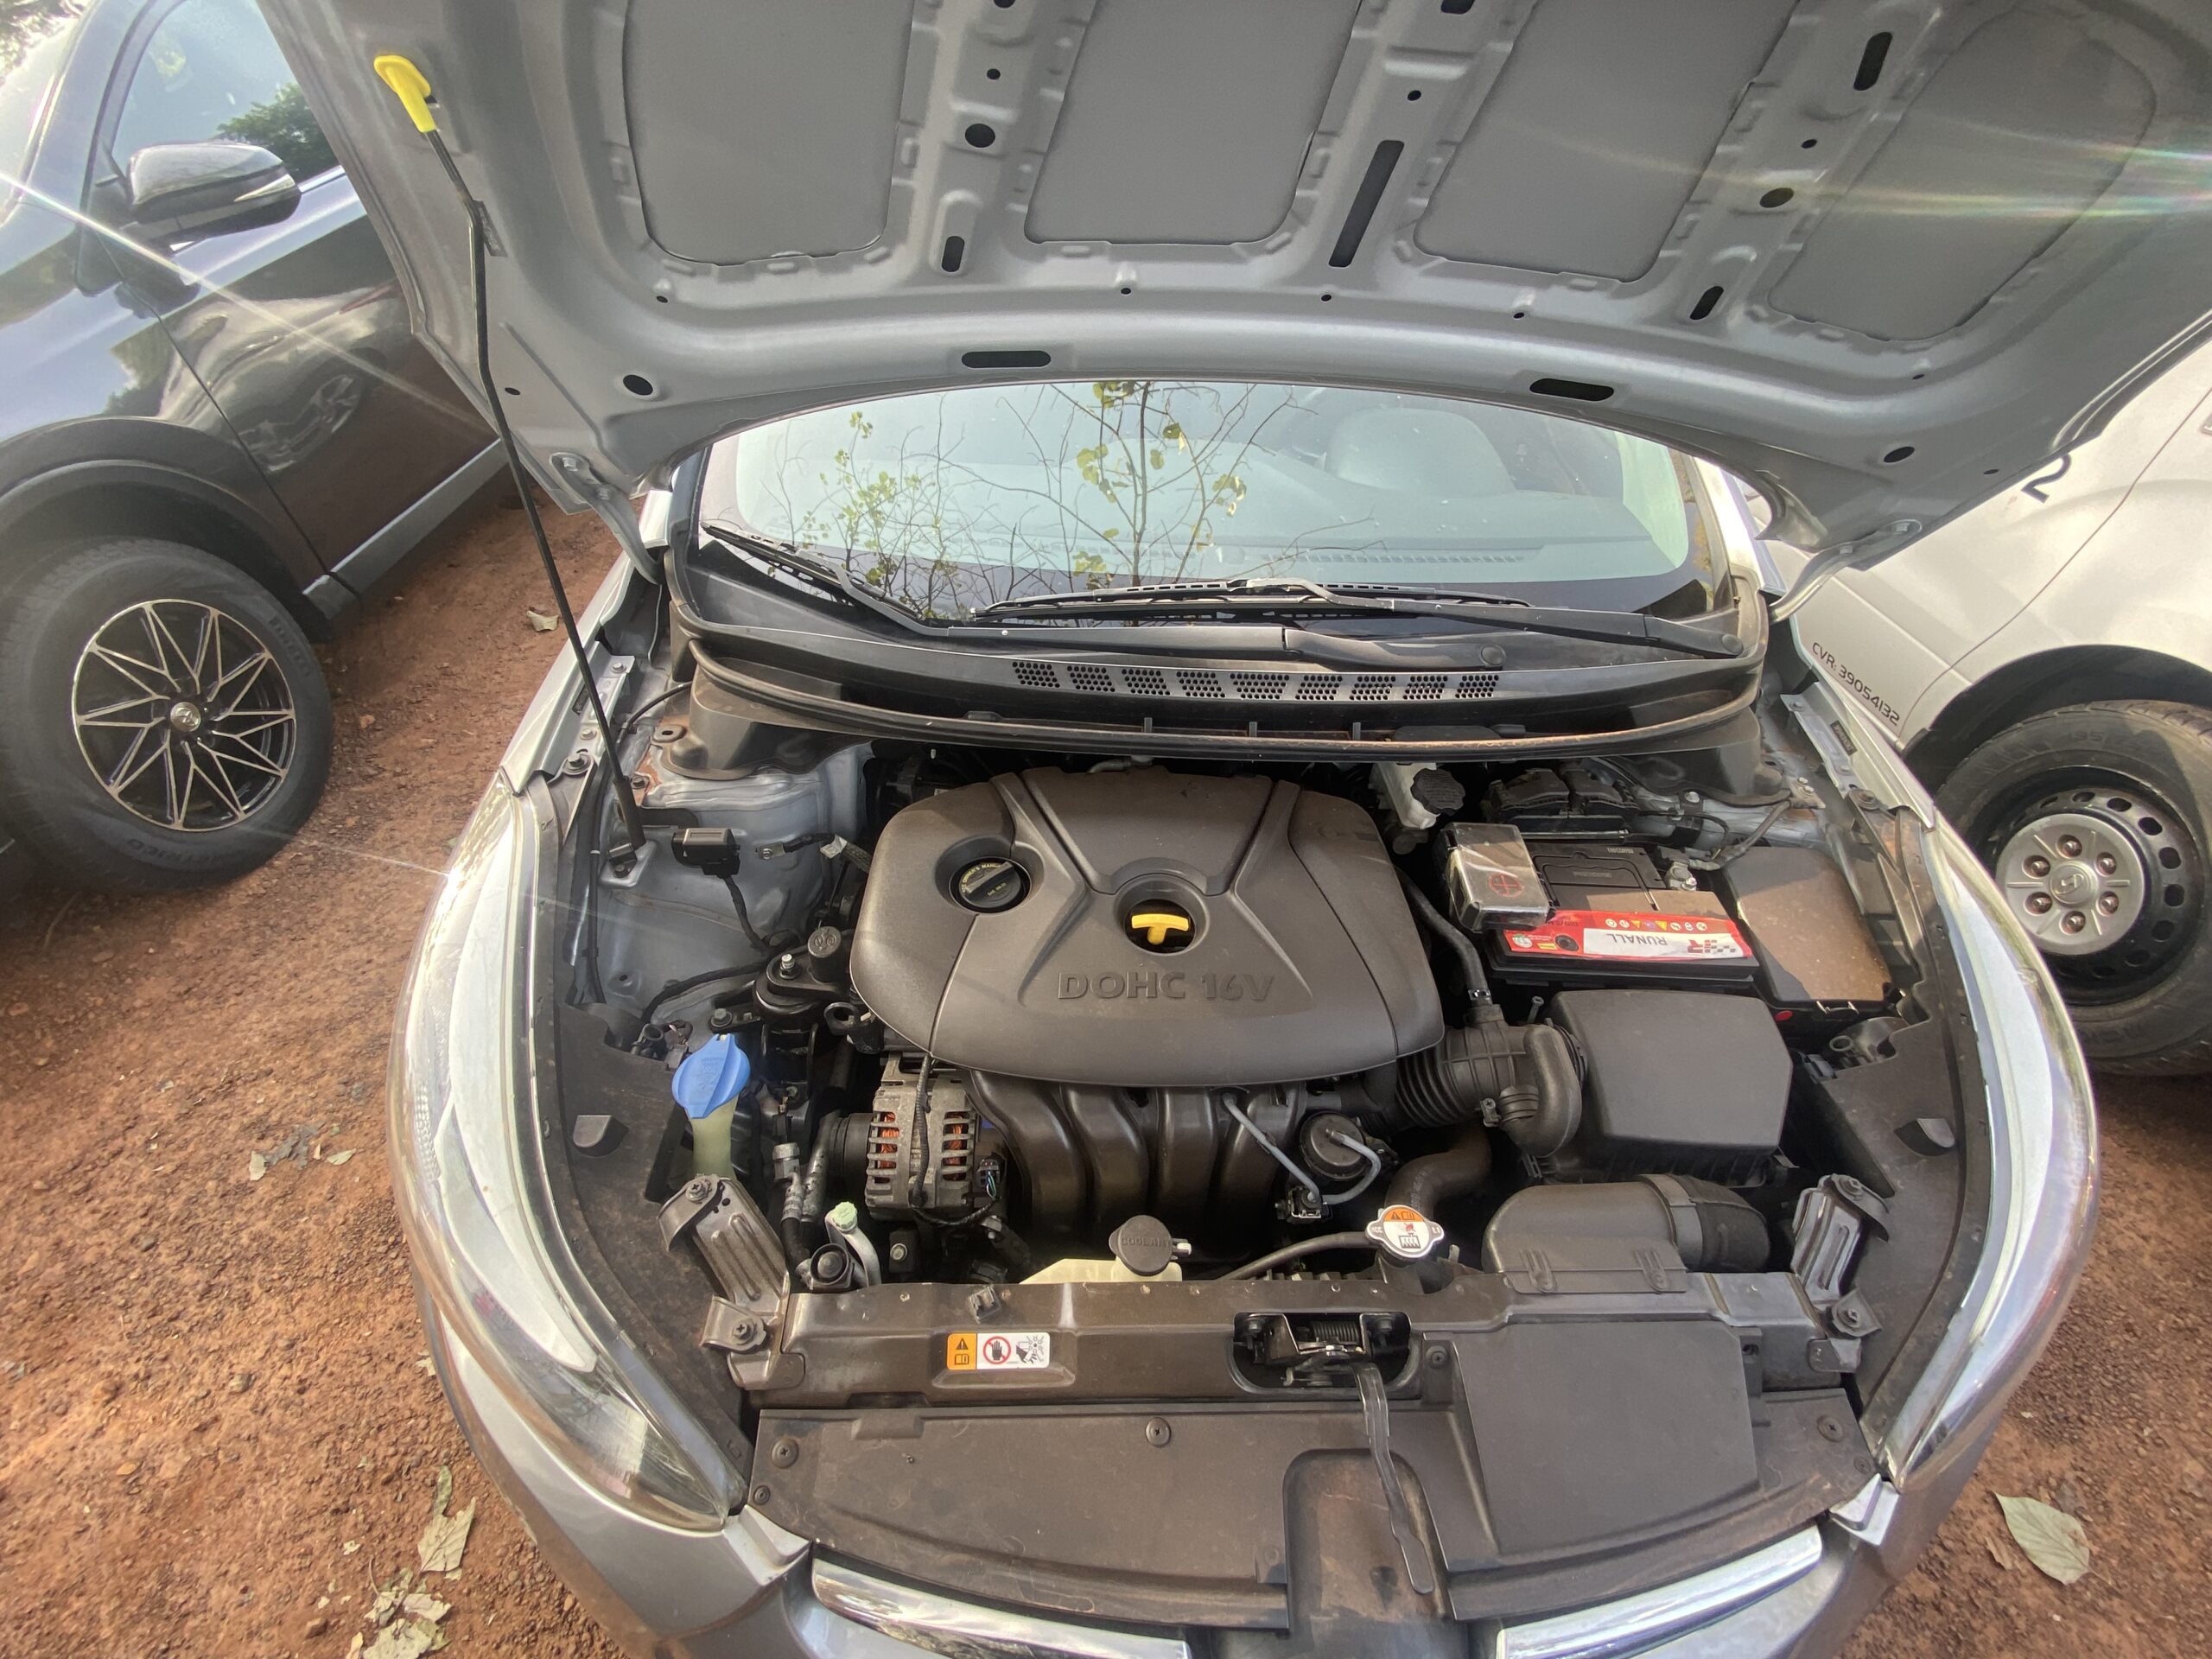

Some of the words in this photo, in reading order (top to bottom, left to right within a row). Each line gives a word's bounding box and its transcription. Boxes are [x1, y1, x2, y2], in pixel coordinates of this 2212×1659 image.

[1812, 642, 1837, 671] CVR:
[1838, 664, 1900, 726] 39054132
[1605, 933, 1669, 947] RUNALL
[1057, 970, 1186, 1000] DOHC
[1201, 971, 1275, 1001] 16V
[1121, 1236, 1171, 1249] COOLANT
